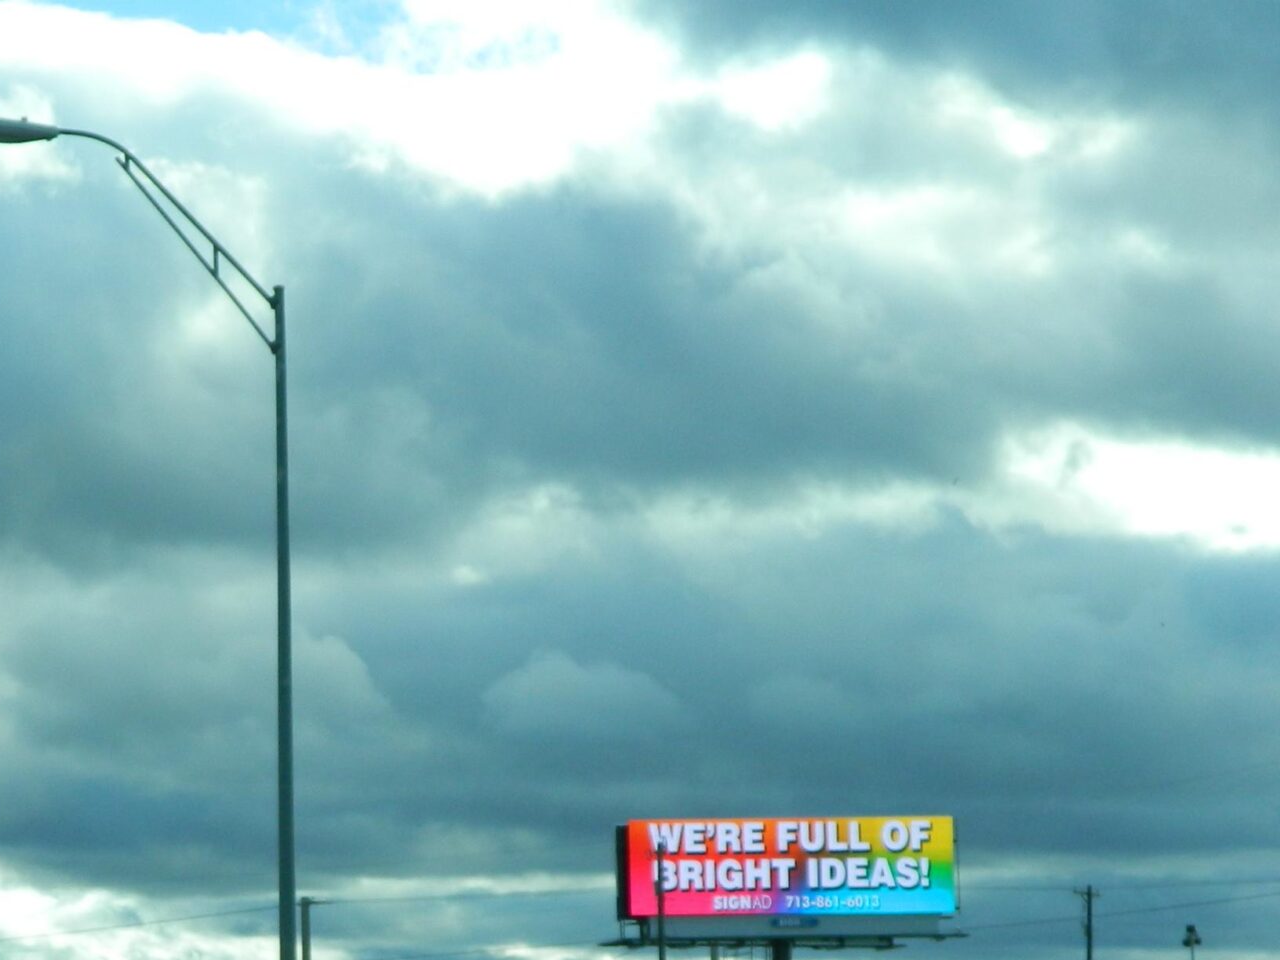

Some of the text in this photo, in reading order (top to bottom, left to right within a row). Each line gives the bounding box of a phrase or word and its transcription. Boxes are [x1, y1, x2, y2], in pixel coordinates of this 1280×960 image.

[648, 820, 932, 853] WE'RE FULL OF
[652, 857, 931, 891] BRIGHT IDEAS!
[786, 894, 881, 909] 713-861-6013
